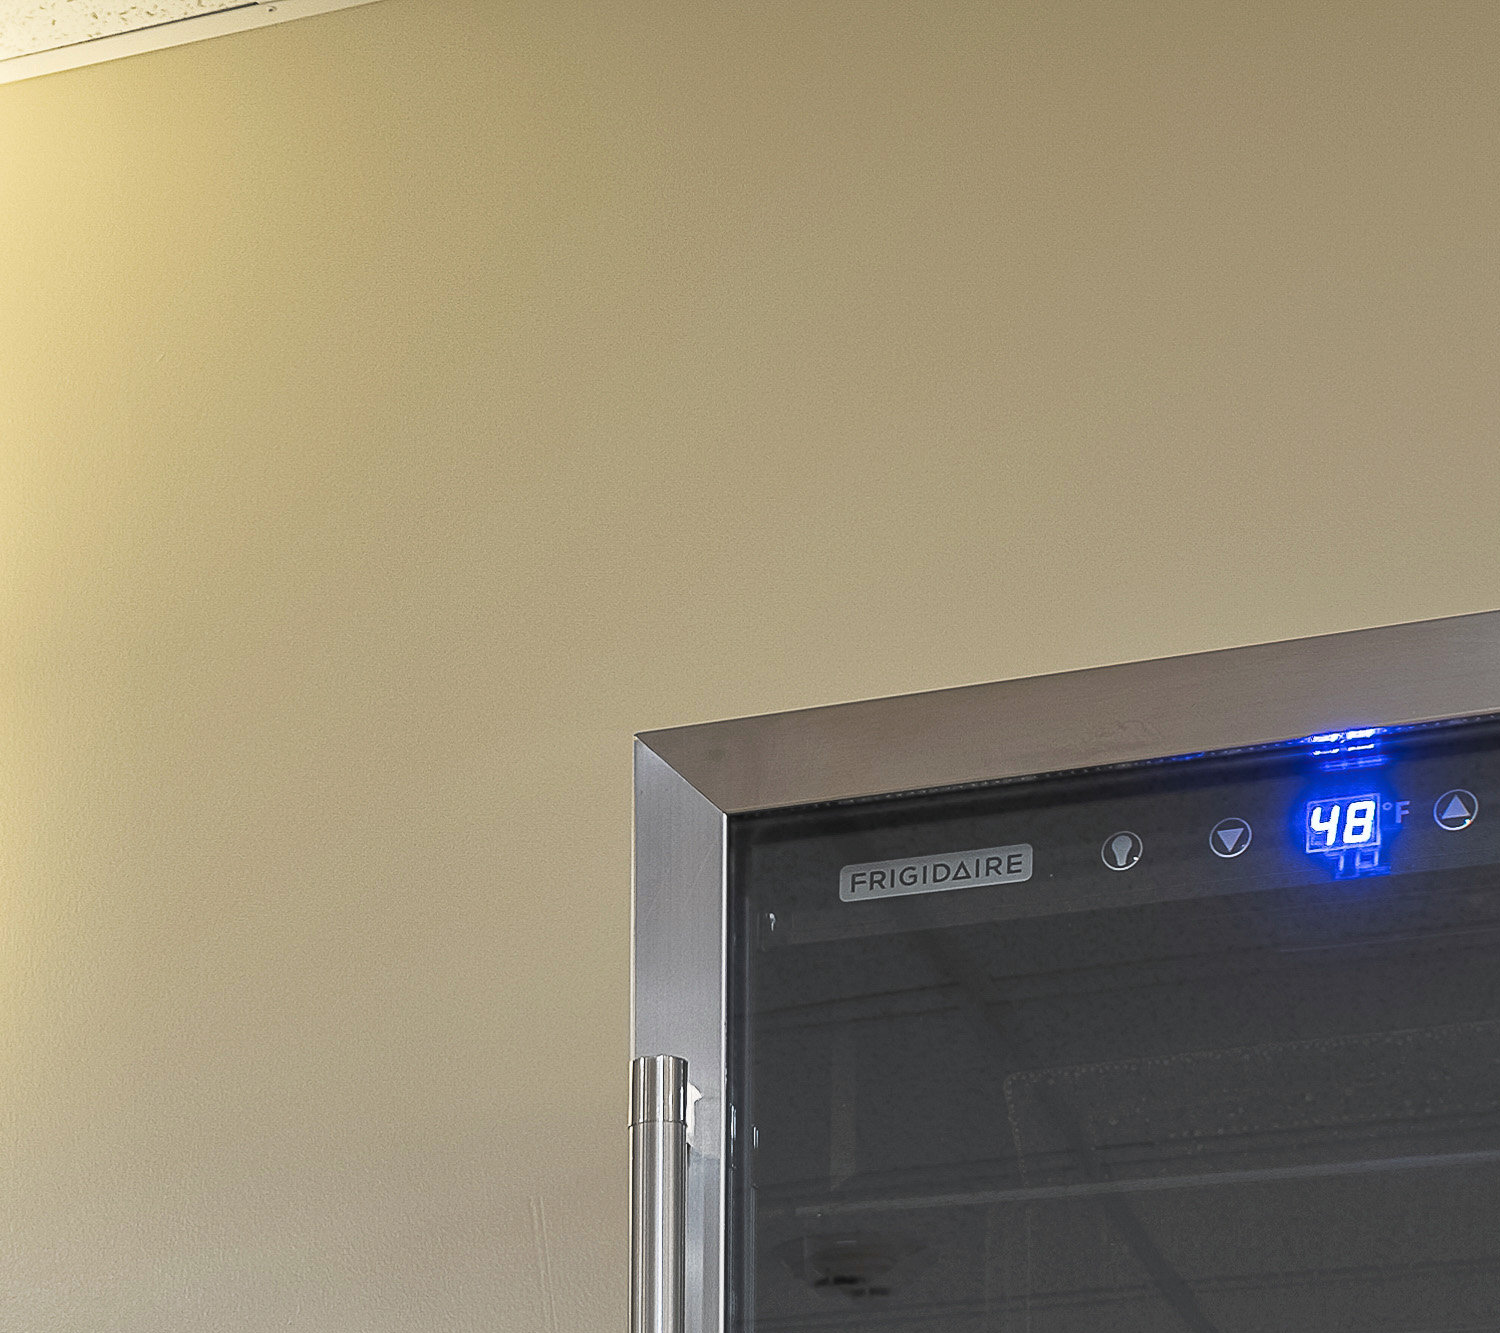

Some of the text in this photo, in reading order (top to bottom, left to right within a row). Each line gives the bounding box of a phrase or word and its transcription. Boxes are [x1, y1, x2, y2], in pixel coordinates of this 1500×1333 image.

[1310, 800, 1410, 846] 48 °F
[850, 853, 1024, 893] FRIGIDAIRE
